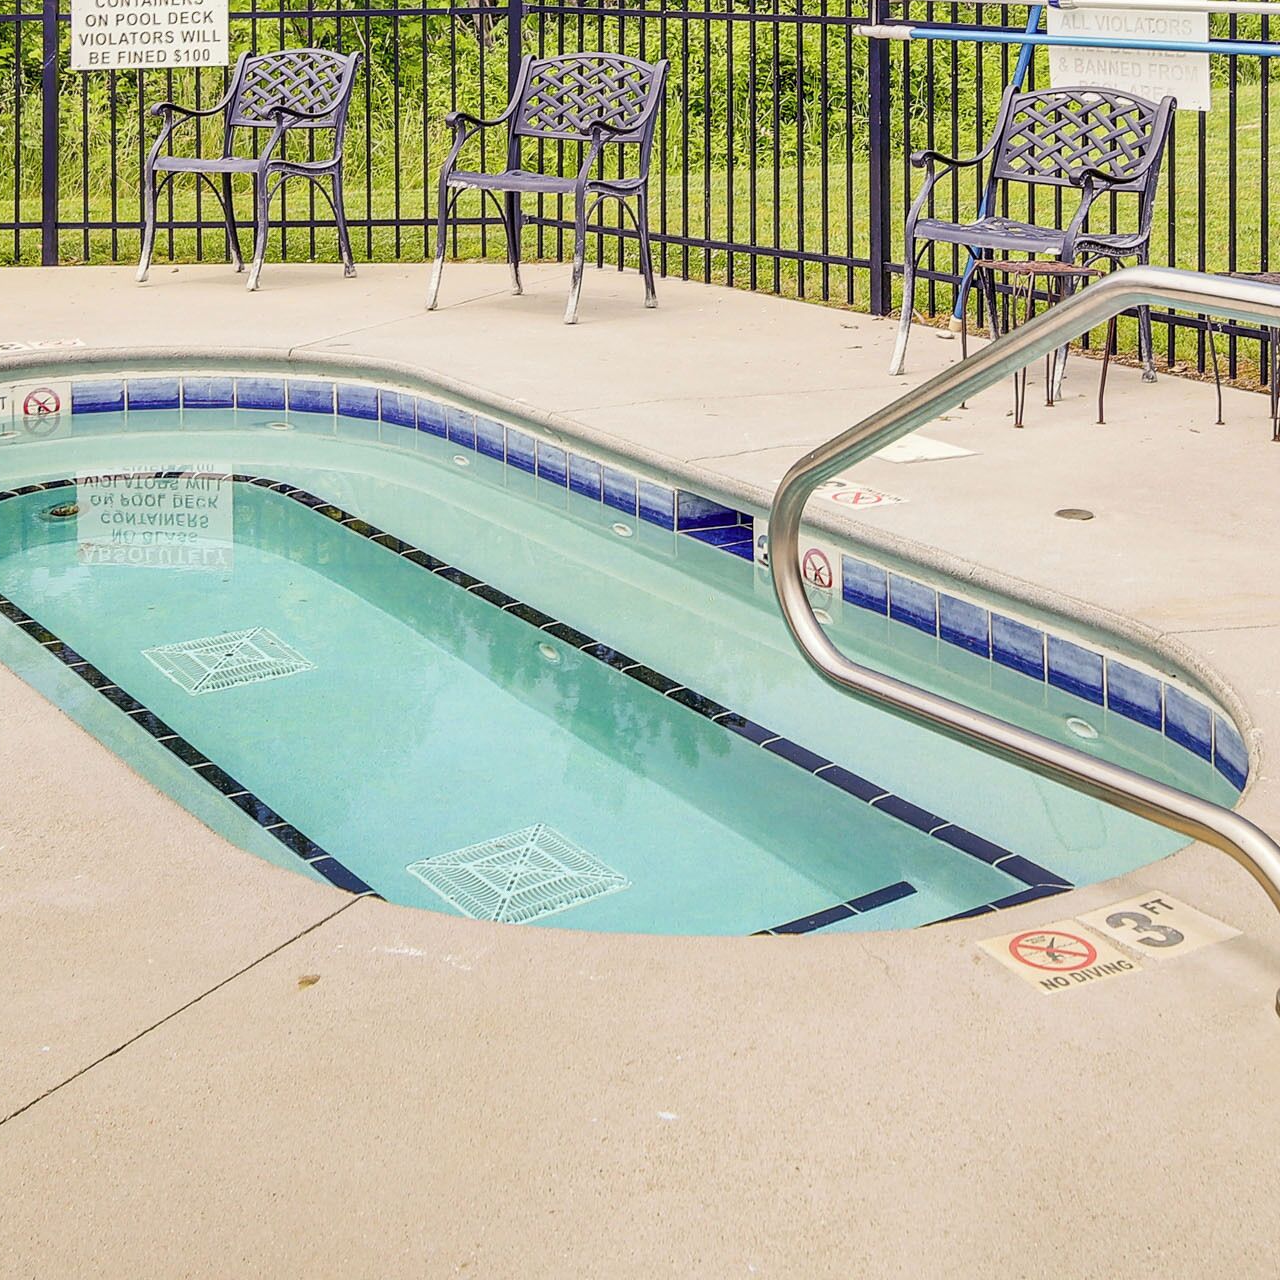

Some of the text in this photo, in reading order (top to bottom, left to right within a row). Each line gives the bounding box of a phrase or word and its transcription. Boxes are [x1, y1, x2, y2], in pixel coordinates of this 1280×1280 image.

[85, 10, 214, 27] ON POOL DECK
[1060, 14, 1193, 36] ALL VIOLATORS
[78, 29, 221, 46] VIOLATORS WILL
[89, 48, 211, 65] BE FINED $100
[1058, 57, 1199, 81] & BANNED FROM
[1105, 898, 1185, 948] 3 FT
[1039, 959, 1135, 991] NO DIVING
